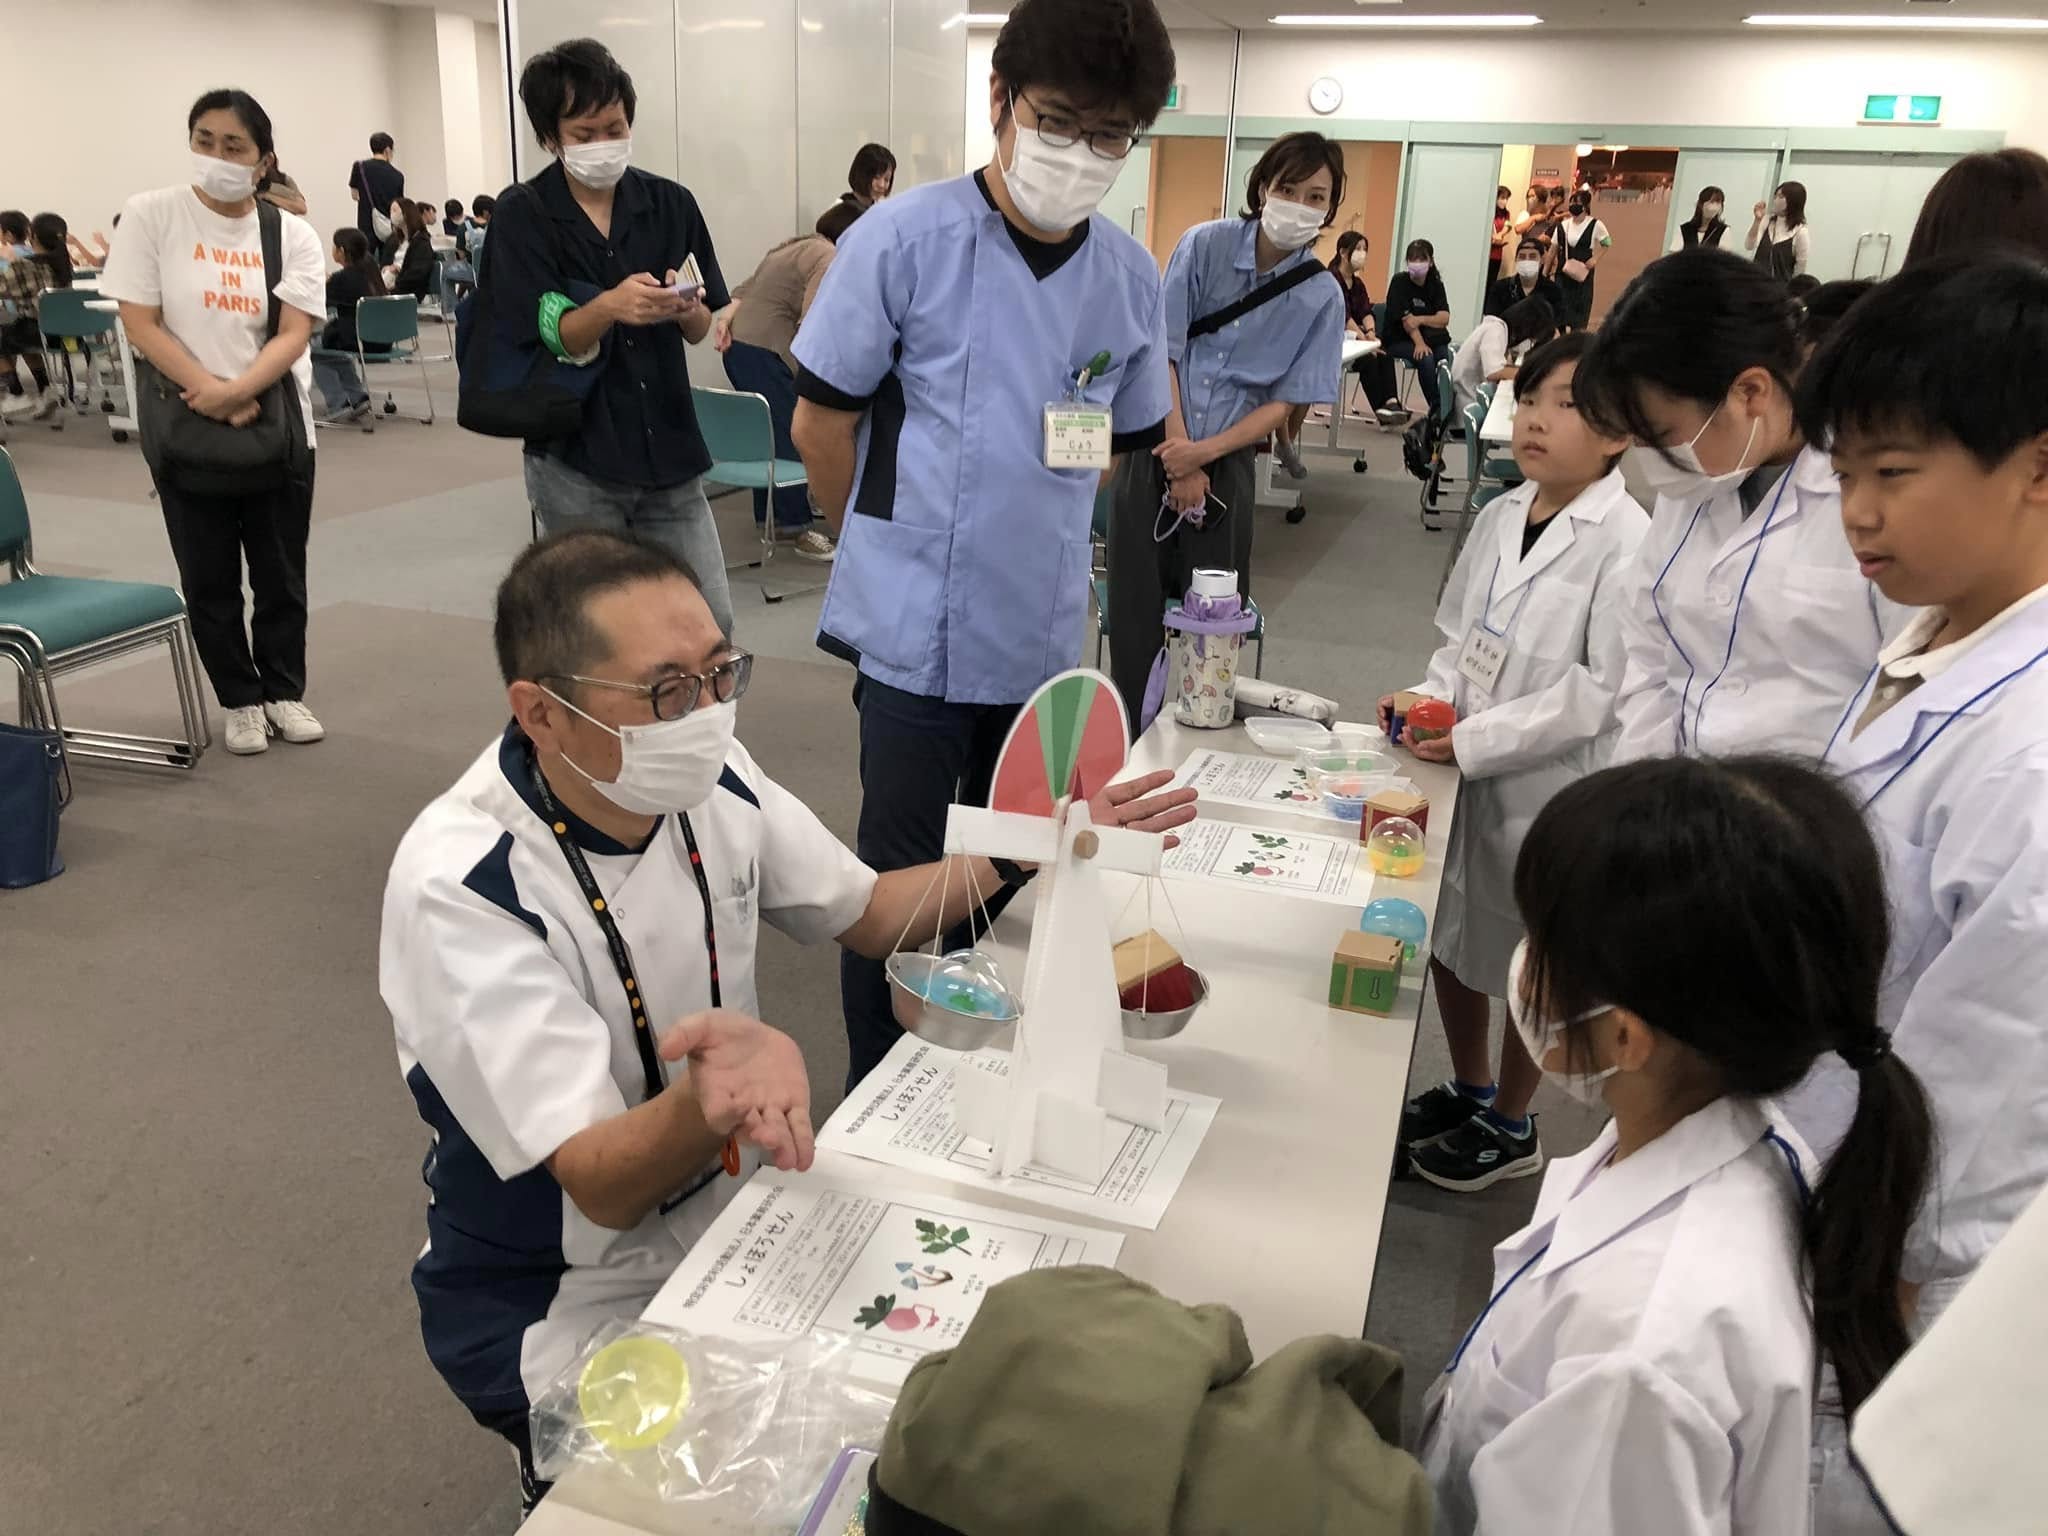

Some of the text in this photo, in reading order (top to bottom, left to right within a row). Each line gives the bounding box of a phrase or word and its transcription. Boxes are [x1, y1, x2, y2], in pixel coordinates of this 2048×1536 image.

[193, 243, 263, 268] A WALK
[221, 271, 241, 288] IN
[204, 291, 262, 316] PARIS
[880, 1066, 938, 1121] しょほうせん
[723, 1210, 794, 1289] しょほうせん
